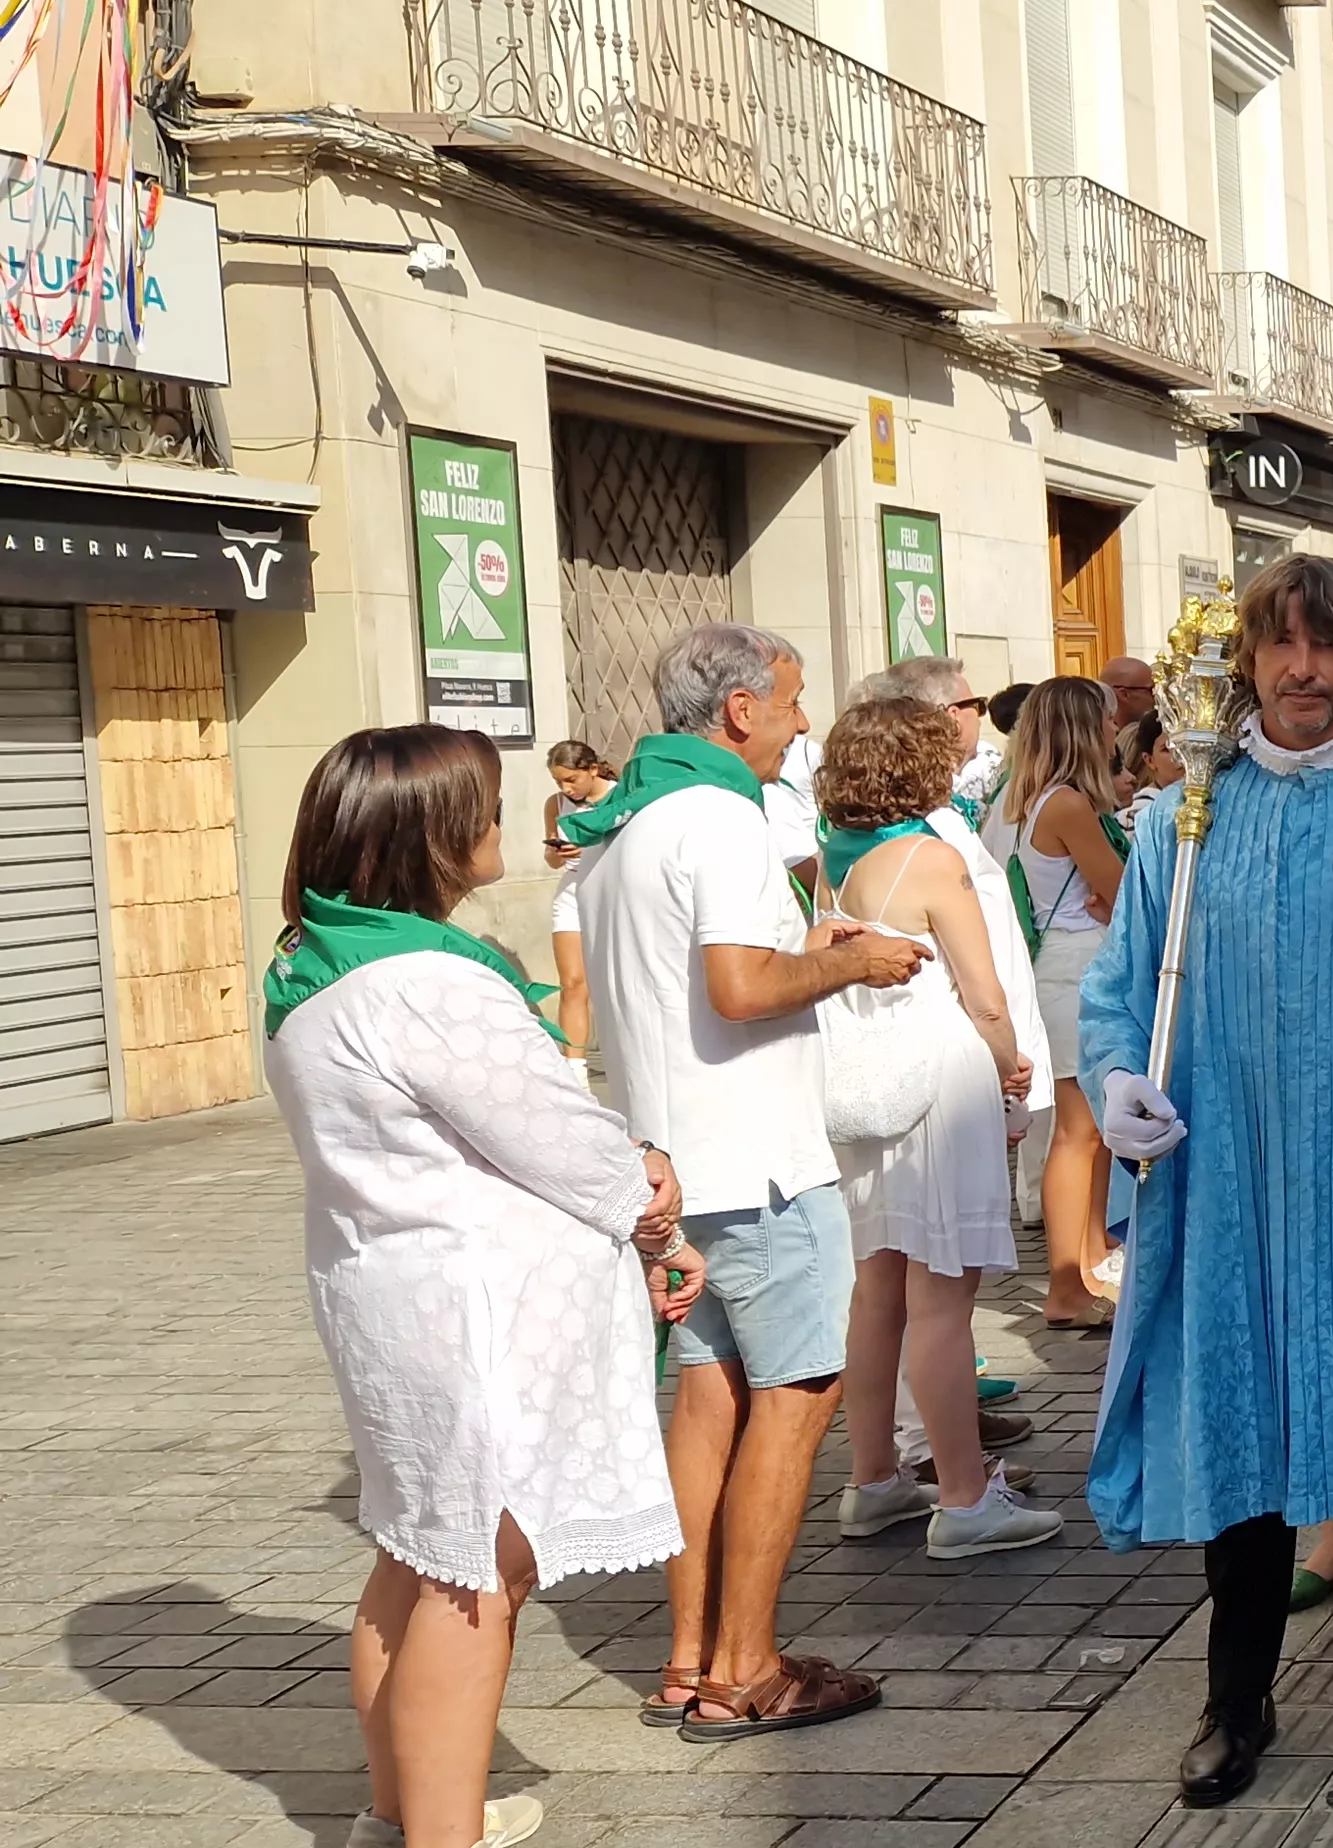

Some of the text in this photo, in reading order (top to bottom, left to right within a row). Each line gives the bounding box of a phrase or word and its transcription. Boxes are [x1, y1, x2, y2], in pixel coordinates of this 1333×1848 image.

[444, 460, 479, 490] FELIZ
[1249, 455, 1286, 488] IN
[420, 489, 506, 526] SAN LORENZO
[900, 527, 919, 548] FELIZ
[477, 553, 505, 573] -50%
[887, 549, 934, 574] SAN LORENZO
